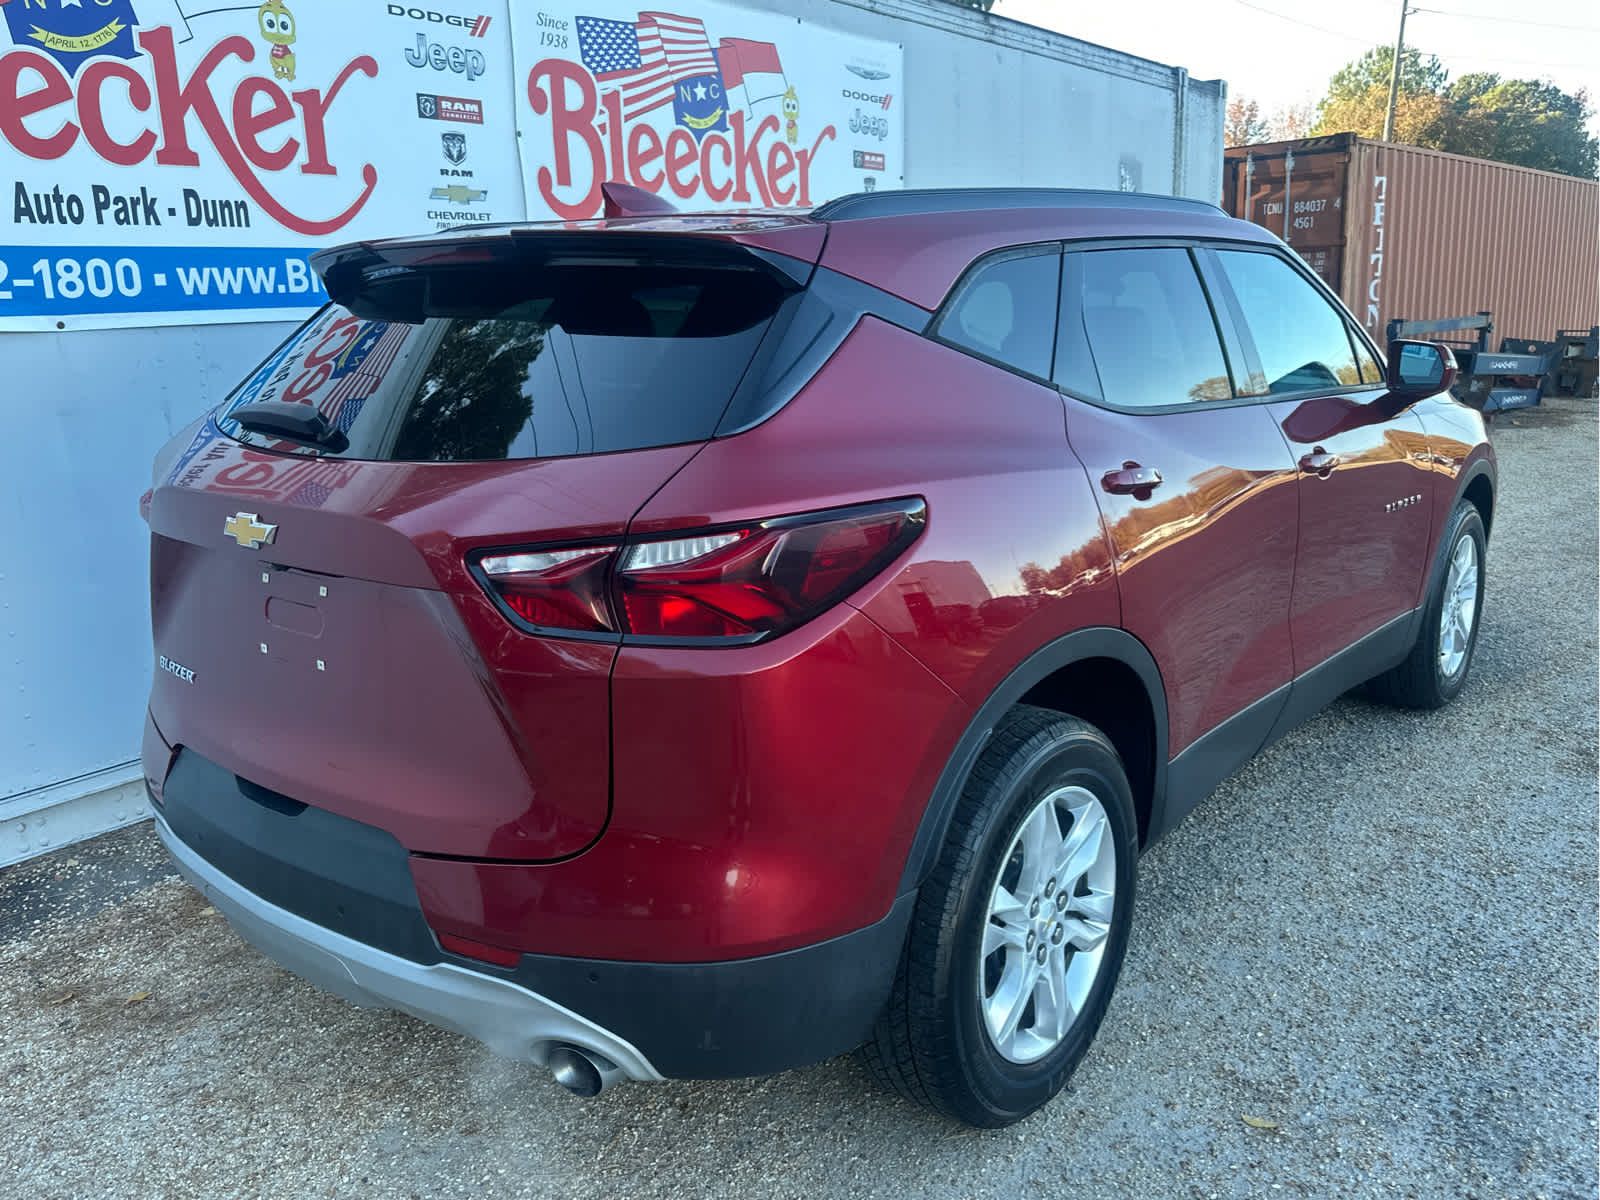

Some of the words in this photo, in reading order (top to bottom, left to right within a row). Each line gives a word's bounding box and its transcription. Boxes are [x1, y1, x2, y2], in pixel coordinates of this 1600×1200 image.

[387, 4, 480, 29] DODGE
[536, 12, 569, 31] Since
[48, 36, 77, 49] APRIL
[539, 31, 568, 49] 1938
[405, 32, 486, 81] Jeep
[680, 84, 691, 103] N
[709, 83, 720, 99] C
[842, 89, 887, 105] DODGE
[441, 100, 479, 112] RAM
[848, 108, 889, 141] Jeep
[527, 58, 837, 221] Bleecker
[440, 168, 473, 177] RAM
[14, 182, 84, 225] Auto
[92, 185, 162, 226] Park
[184, 188, 250, 228] Dunn
[1334, 196, 1341, 209] 4
[427, 210, 492, 222] CHEVROLET
[1293, 216, 1314, 229] 45G1
[177, 258, 328, 296] www.Bl
[160, 655, 194, 685] BLAZER
